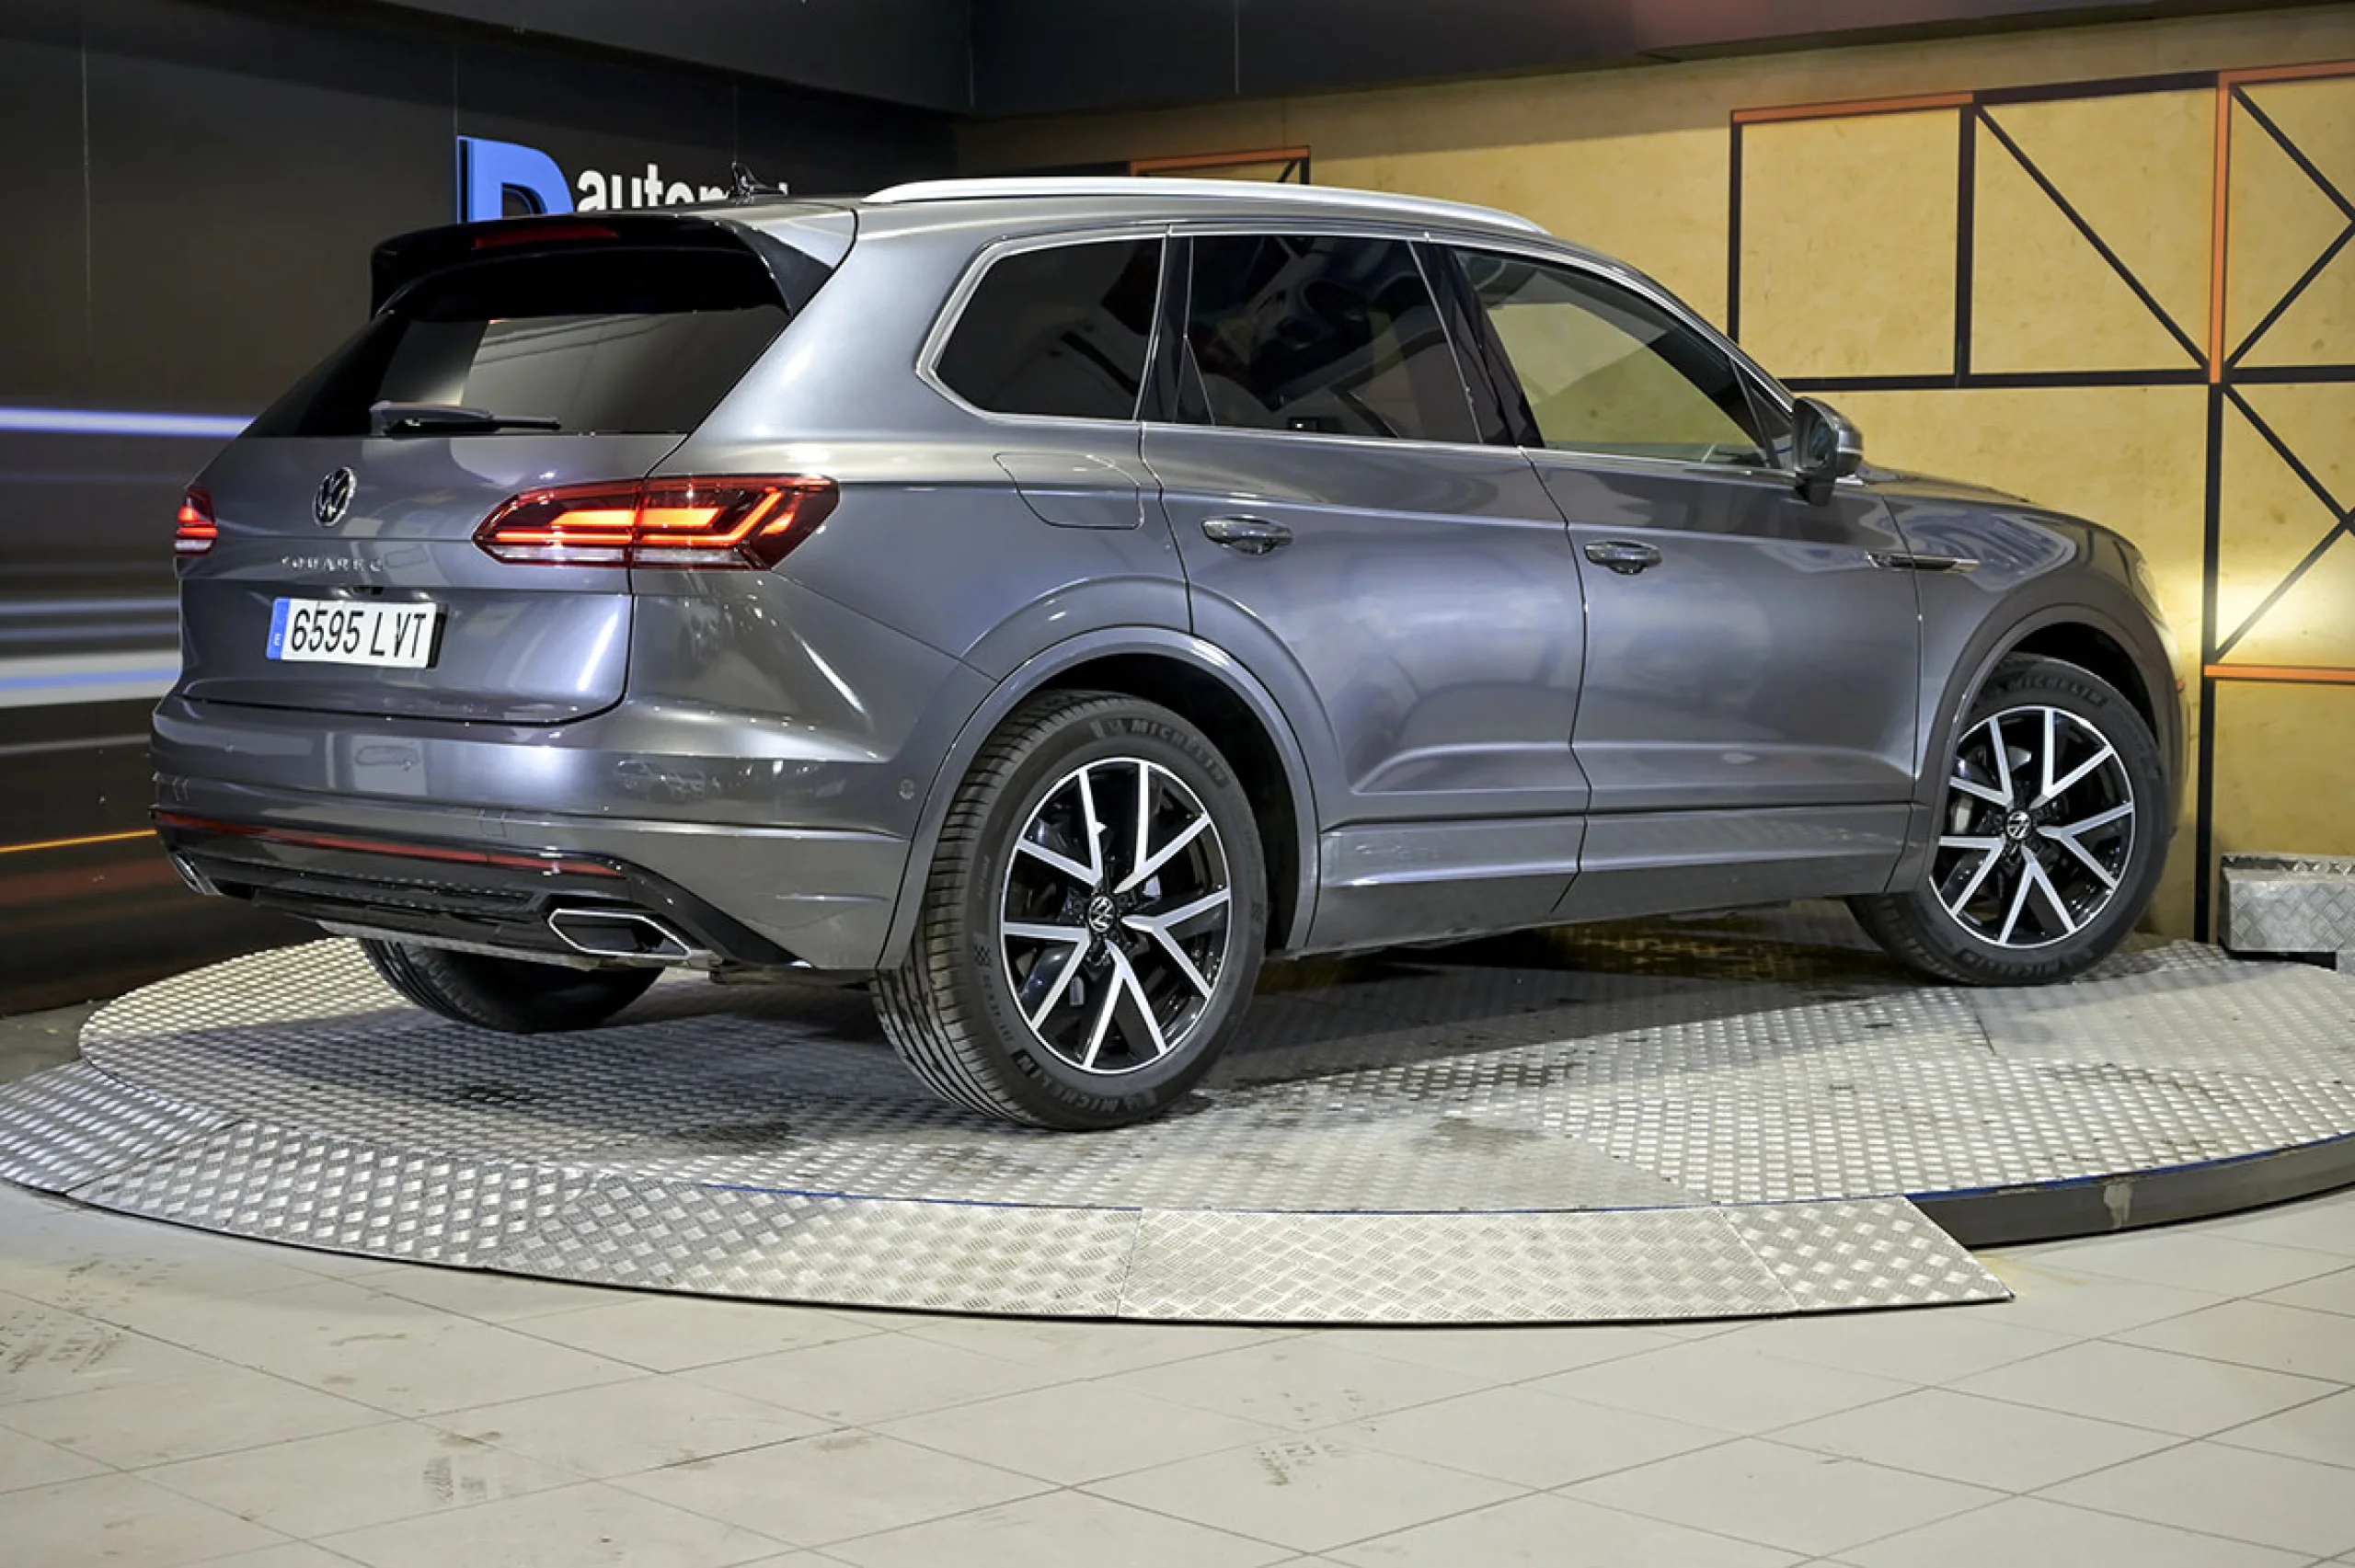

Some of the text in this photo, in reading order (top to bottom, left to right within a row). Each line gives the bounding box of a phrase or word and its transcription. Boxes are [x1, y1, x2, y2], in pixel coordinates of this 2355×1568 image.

[292, 608, 427, 658] 6595 LVT
[1132, 718, 1230, 787] MICHELIN
